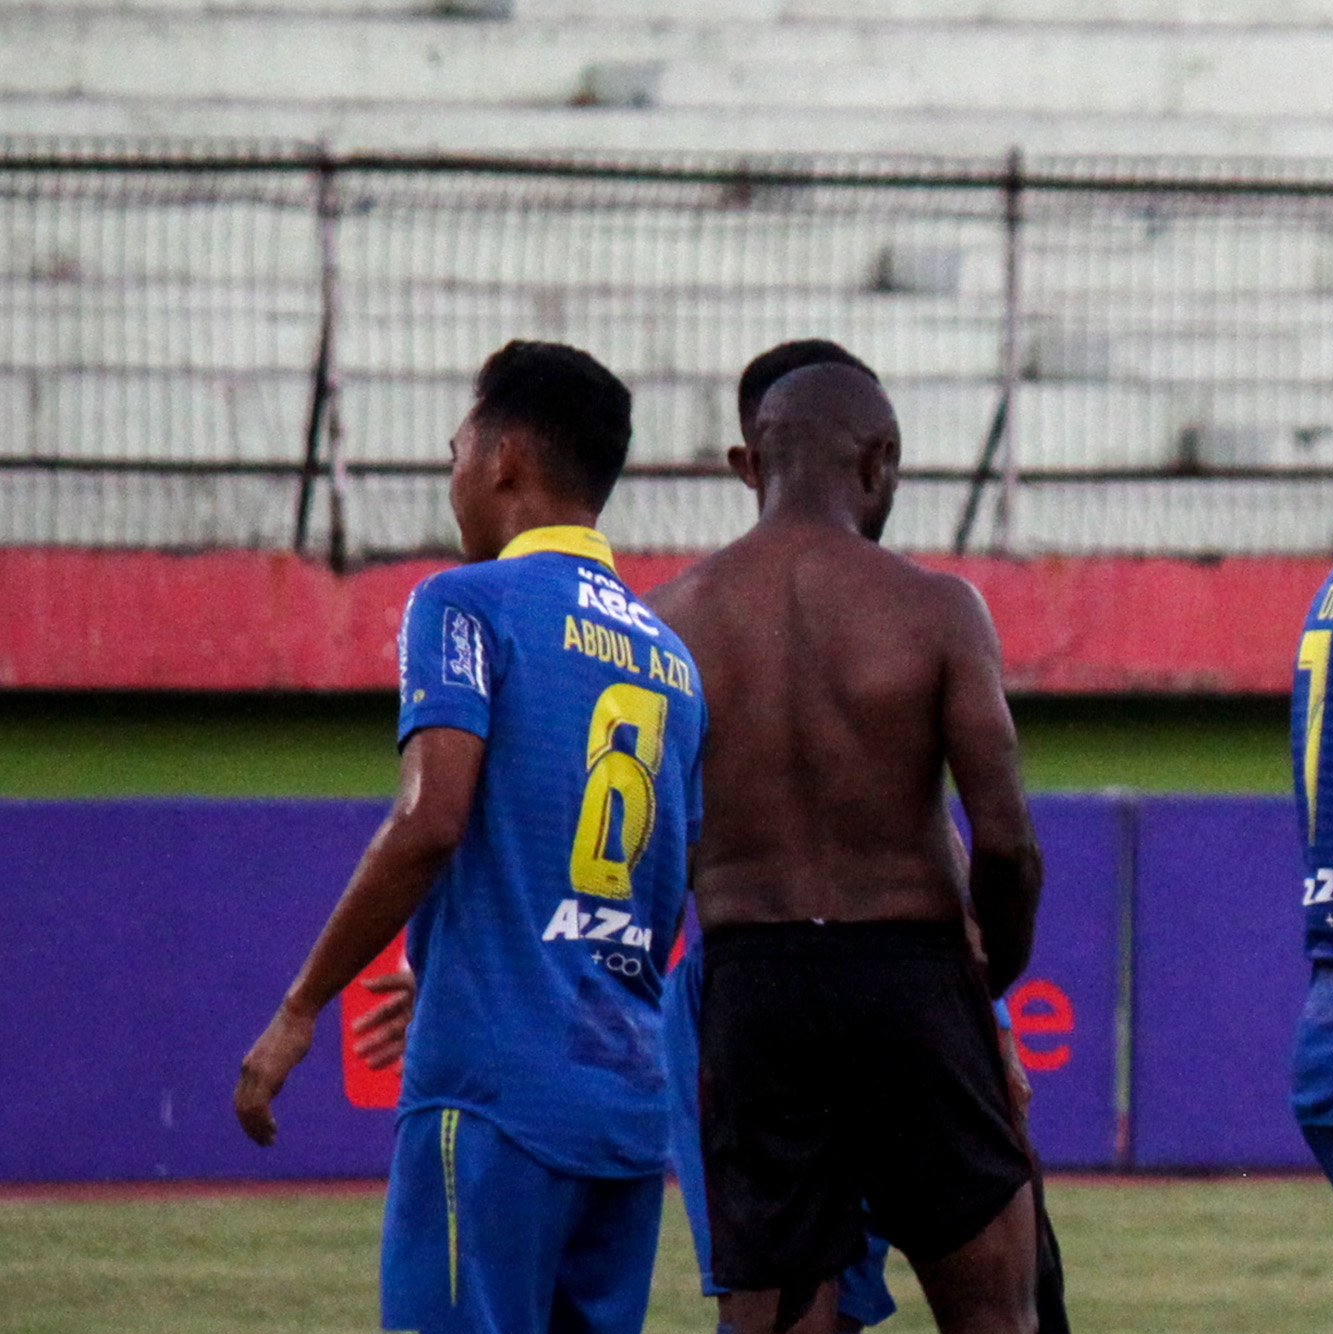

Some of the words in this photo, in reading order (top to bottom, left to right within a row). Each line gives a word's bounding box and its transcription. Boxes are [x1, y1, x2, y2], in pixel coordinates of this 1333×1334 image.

[577, 580, 660, 637] ABC
[563, 614, 641, 674] ABDUL
[649, 645, 694, 697] AZIZ
[569, 682, 668, 900] 8
